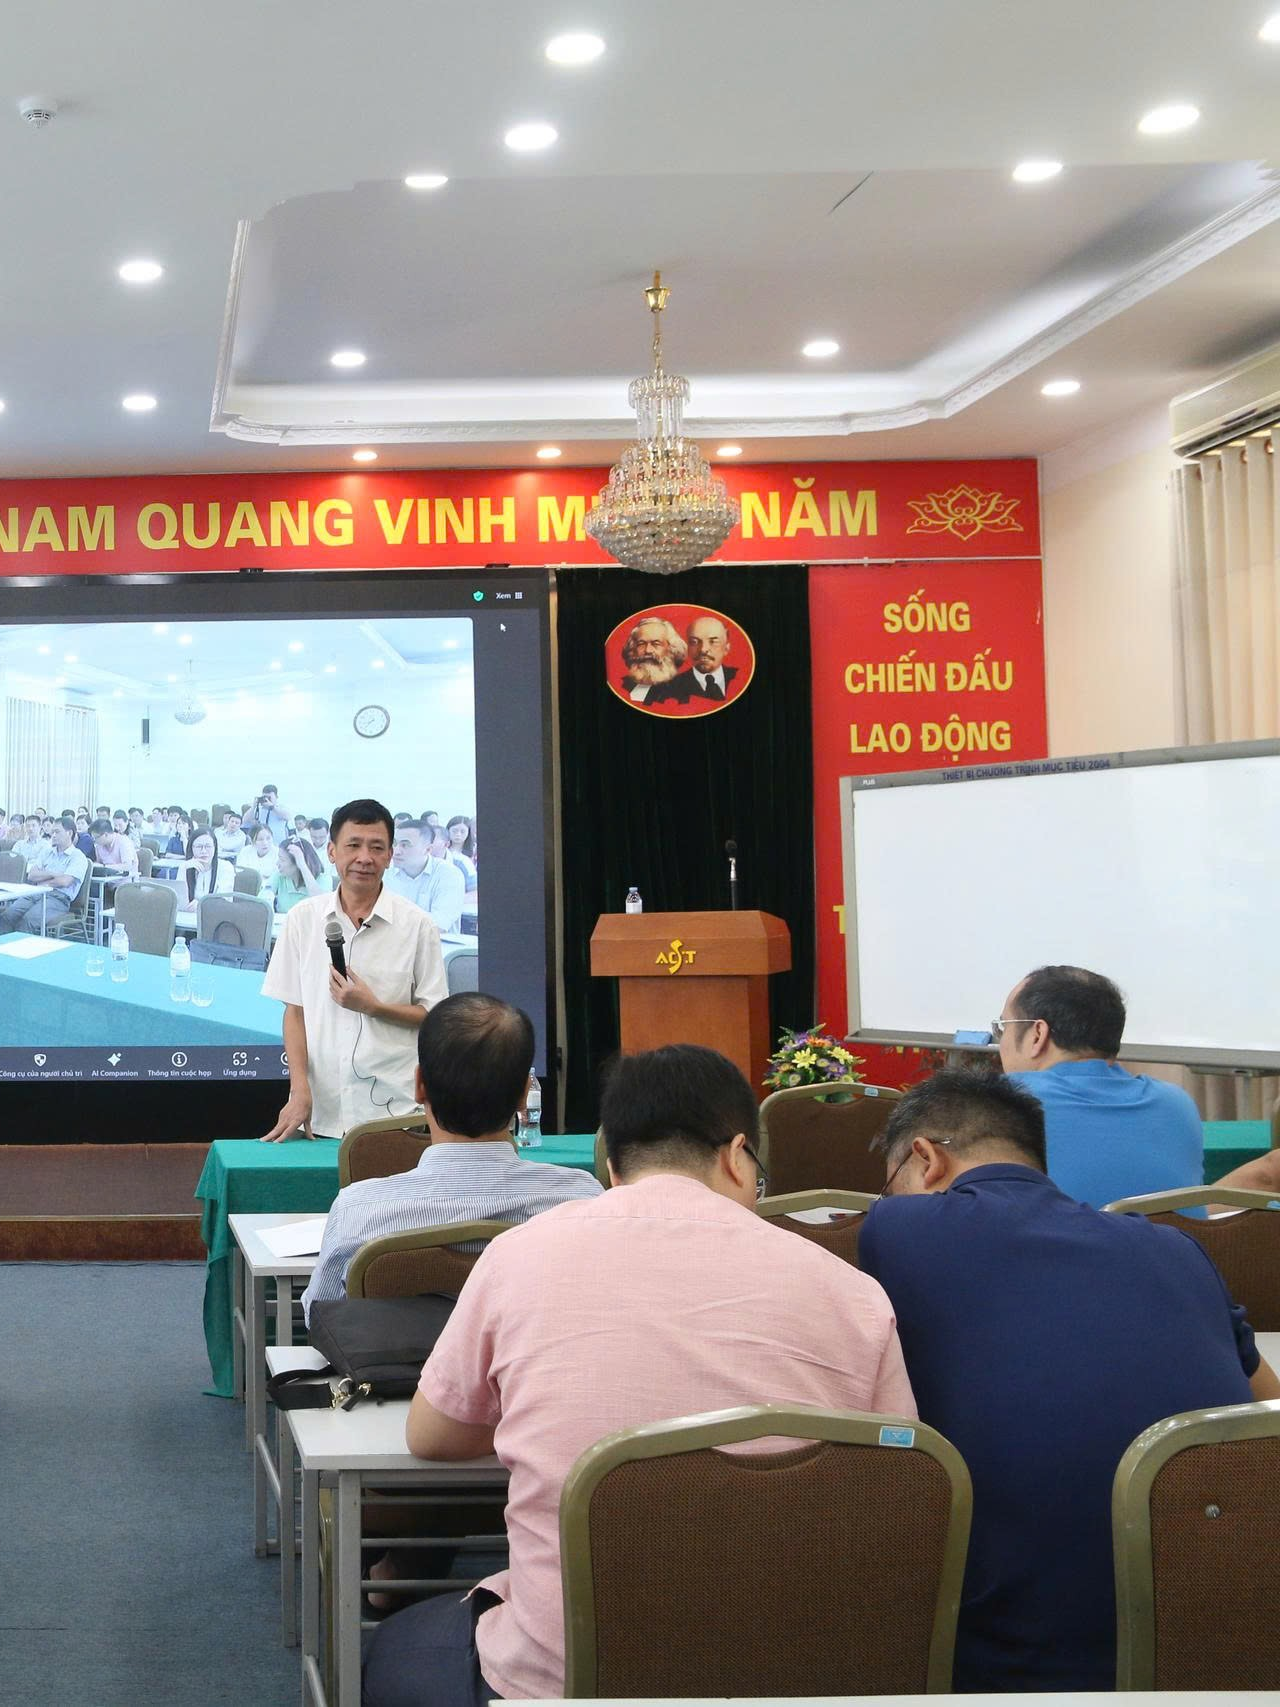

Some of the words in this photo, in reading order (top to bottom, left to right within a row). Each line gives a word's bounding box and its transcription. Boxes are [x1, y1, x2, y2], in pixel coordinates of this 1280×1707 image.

[136, 498, 355, 550] QUANG
[373, 495, 517, 545] VINH
[739, 476, 878, 540] NĂM
[496, 592, 512, 600] Xem
[883, 589, 971, 633] SỐNG
[844, 649, 936, 694] CHIẾN
[945, 647, 1013, 692] ĐẤU
[850, 722, 912, 753] LAO
[920, 713, 1011, 762] ĐỘNG
[1088, 759, 1111, 770] 2004
[27, 1070, 39, 1078] của
[101, 1070, 138, 1078] Companion
[148, 1070, 169, 1078] Thông
[198, 1070, 212, 1078] họp
[239, 1069, 257, 1077] dụng
